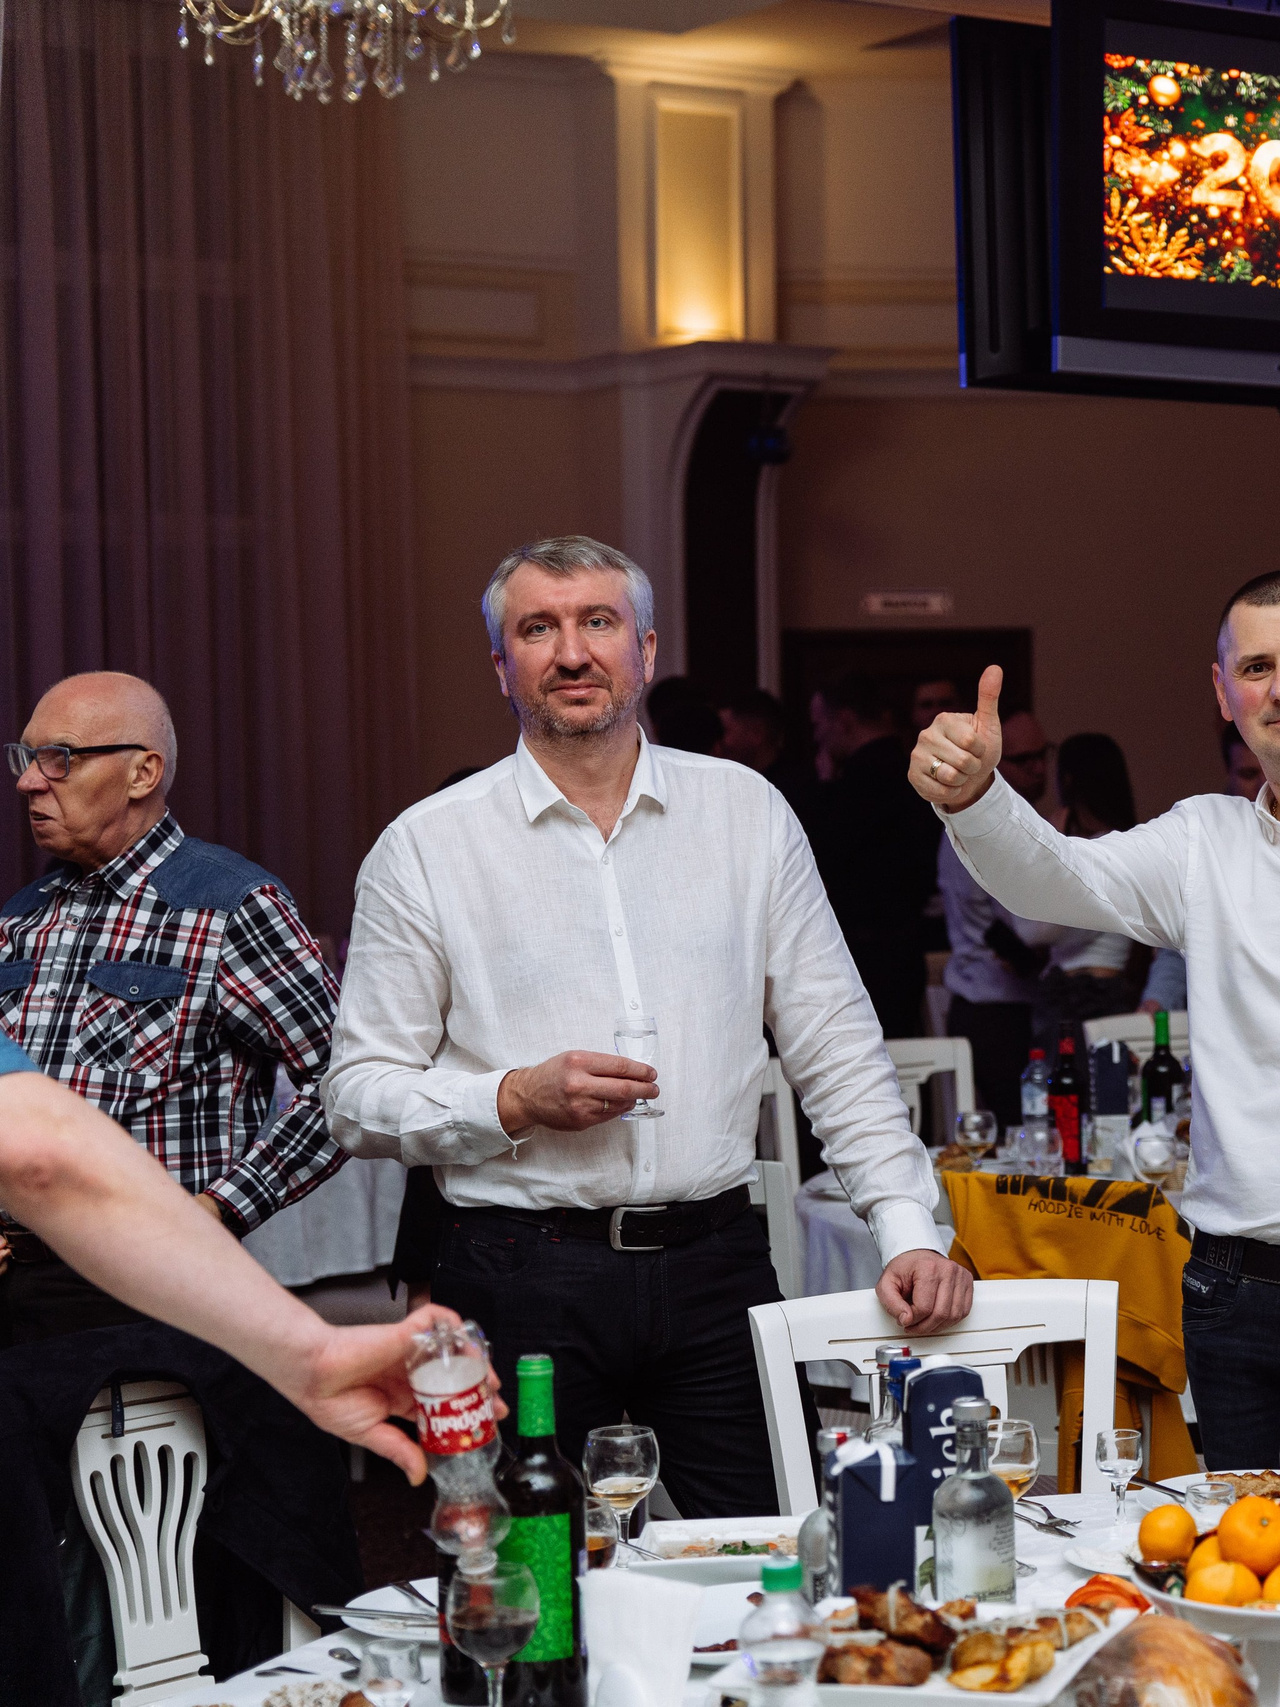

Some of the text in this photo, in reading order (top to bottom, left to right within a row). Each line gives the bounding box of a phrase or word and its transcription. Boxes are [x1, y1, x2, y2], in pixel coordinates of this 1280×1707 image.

[1028, 1198, 1166, 1241] HOODIE WITH LOVE
